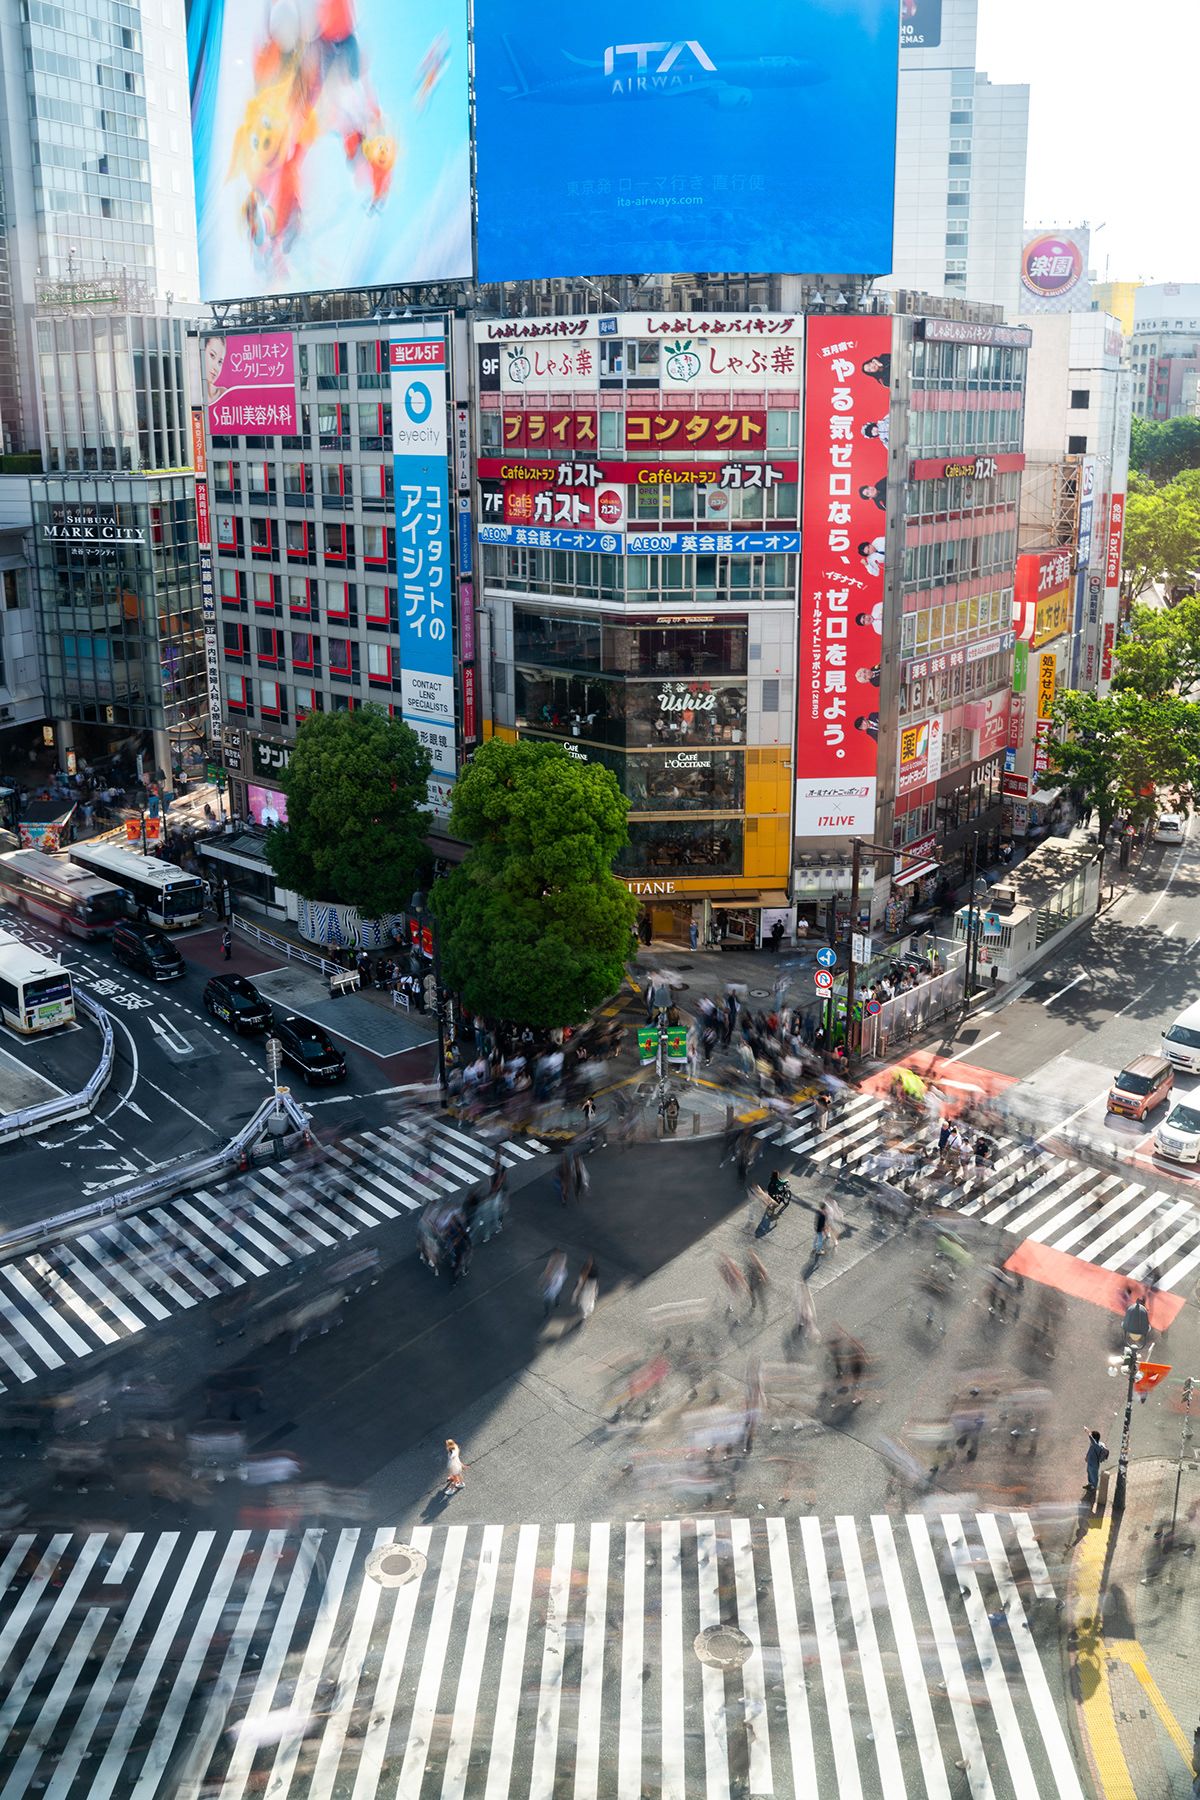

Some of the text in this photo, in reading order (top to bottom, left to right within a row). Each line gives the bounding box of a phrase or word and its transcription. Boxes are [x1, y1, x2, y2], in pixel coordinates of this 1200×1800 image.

[604, 40, 718, 77] ITA
[618, 174, 705, 193] ローマ行き
[712, 173, 767, 192] 直行便
[617, 195, 704, 208] ita-airways.com
[1029, 254, 1074, 278] 楽園
[487, 319, 589, 339] しゃぶしゃぶバイキング
[647, 317, 795, 334] しゃぶしゃぶバイキング
[242, 342, 290, 361] 品川スキン
[395, 344, 440, 362] 当ビル5F
[709, 345, 795, 375] しゃぶ葉
[243, 361, 285, 379] クリニック
[482, 358, 499, 375] 9F
[533, 348, 593, 377] しゃぶ葉
[220, 403, 293, 426] 品川美容外科
[398, 428, 440, 447] eyecity
[504, 415, 597, 441] プライス
[627, 415, 763, 443] コンタクト
[827, 358, 856, 565] やる気ゼロなら、
[974, 457, 998, 480] ガスト
[557, 461, 604, 488] ガスト
[719, 463, 785, 490] ガスト
[483, 493, 504, 512] 7F
[508, 493, 533, 509] Café
[533, 490, 591, 525] ガスト
[600, 504, 621, 516] ガスト
[66, 515, 116, 525] SHIBUYA
[43, 525, 145, 539] MARK CITY
[481, 526, 617, 551] AEON 英会話イーオン 6F
[632, 535, 798, 552] AEON 英会話イーオン
[400, 484, 427, 640] アイシティ
[425, 485, 446, 641] コンタクトの
[1107, 531, 1121, 578] TaxFree
[825, 571, 863, 589] イチナナで
[1037, 555, 1071, 592] スギ薬局
[204, 611, 214, 619] 5F
[206, 626, 215, 635] 3F
[1002, 632, 1015, 650] 4F
[207, 647, 217, 665] 内科
[823, 588, 849, 759] ゼロを見よう。
[411, 678, 443, 692] CONTACT
[407, 697, 449, 713] SPECIALISTS
[418, 690, 436, 701] LENS
[656, 692, 717, 712] Ushi8
[985, 715, 1004, 739] アコム
[415, 727, 449, 749] 形眼镜
[563, 741, 579, 753] CAFÉ
[902, 732, 915, 760] 薬
[664, 759, 712, 769] L'OCCITANE
[677, 752, 698, 762] CAFÉ
[899, 765, 927, 788] サンドラッグ
[970, 757, 1001, 789] LUSH
[817, 815, 855, 827] 17LIVE
[628, 881, 676, 895] ITANE
